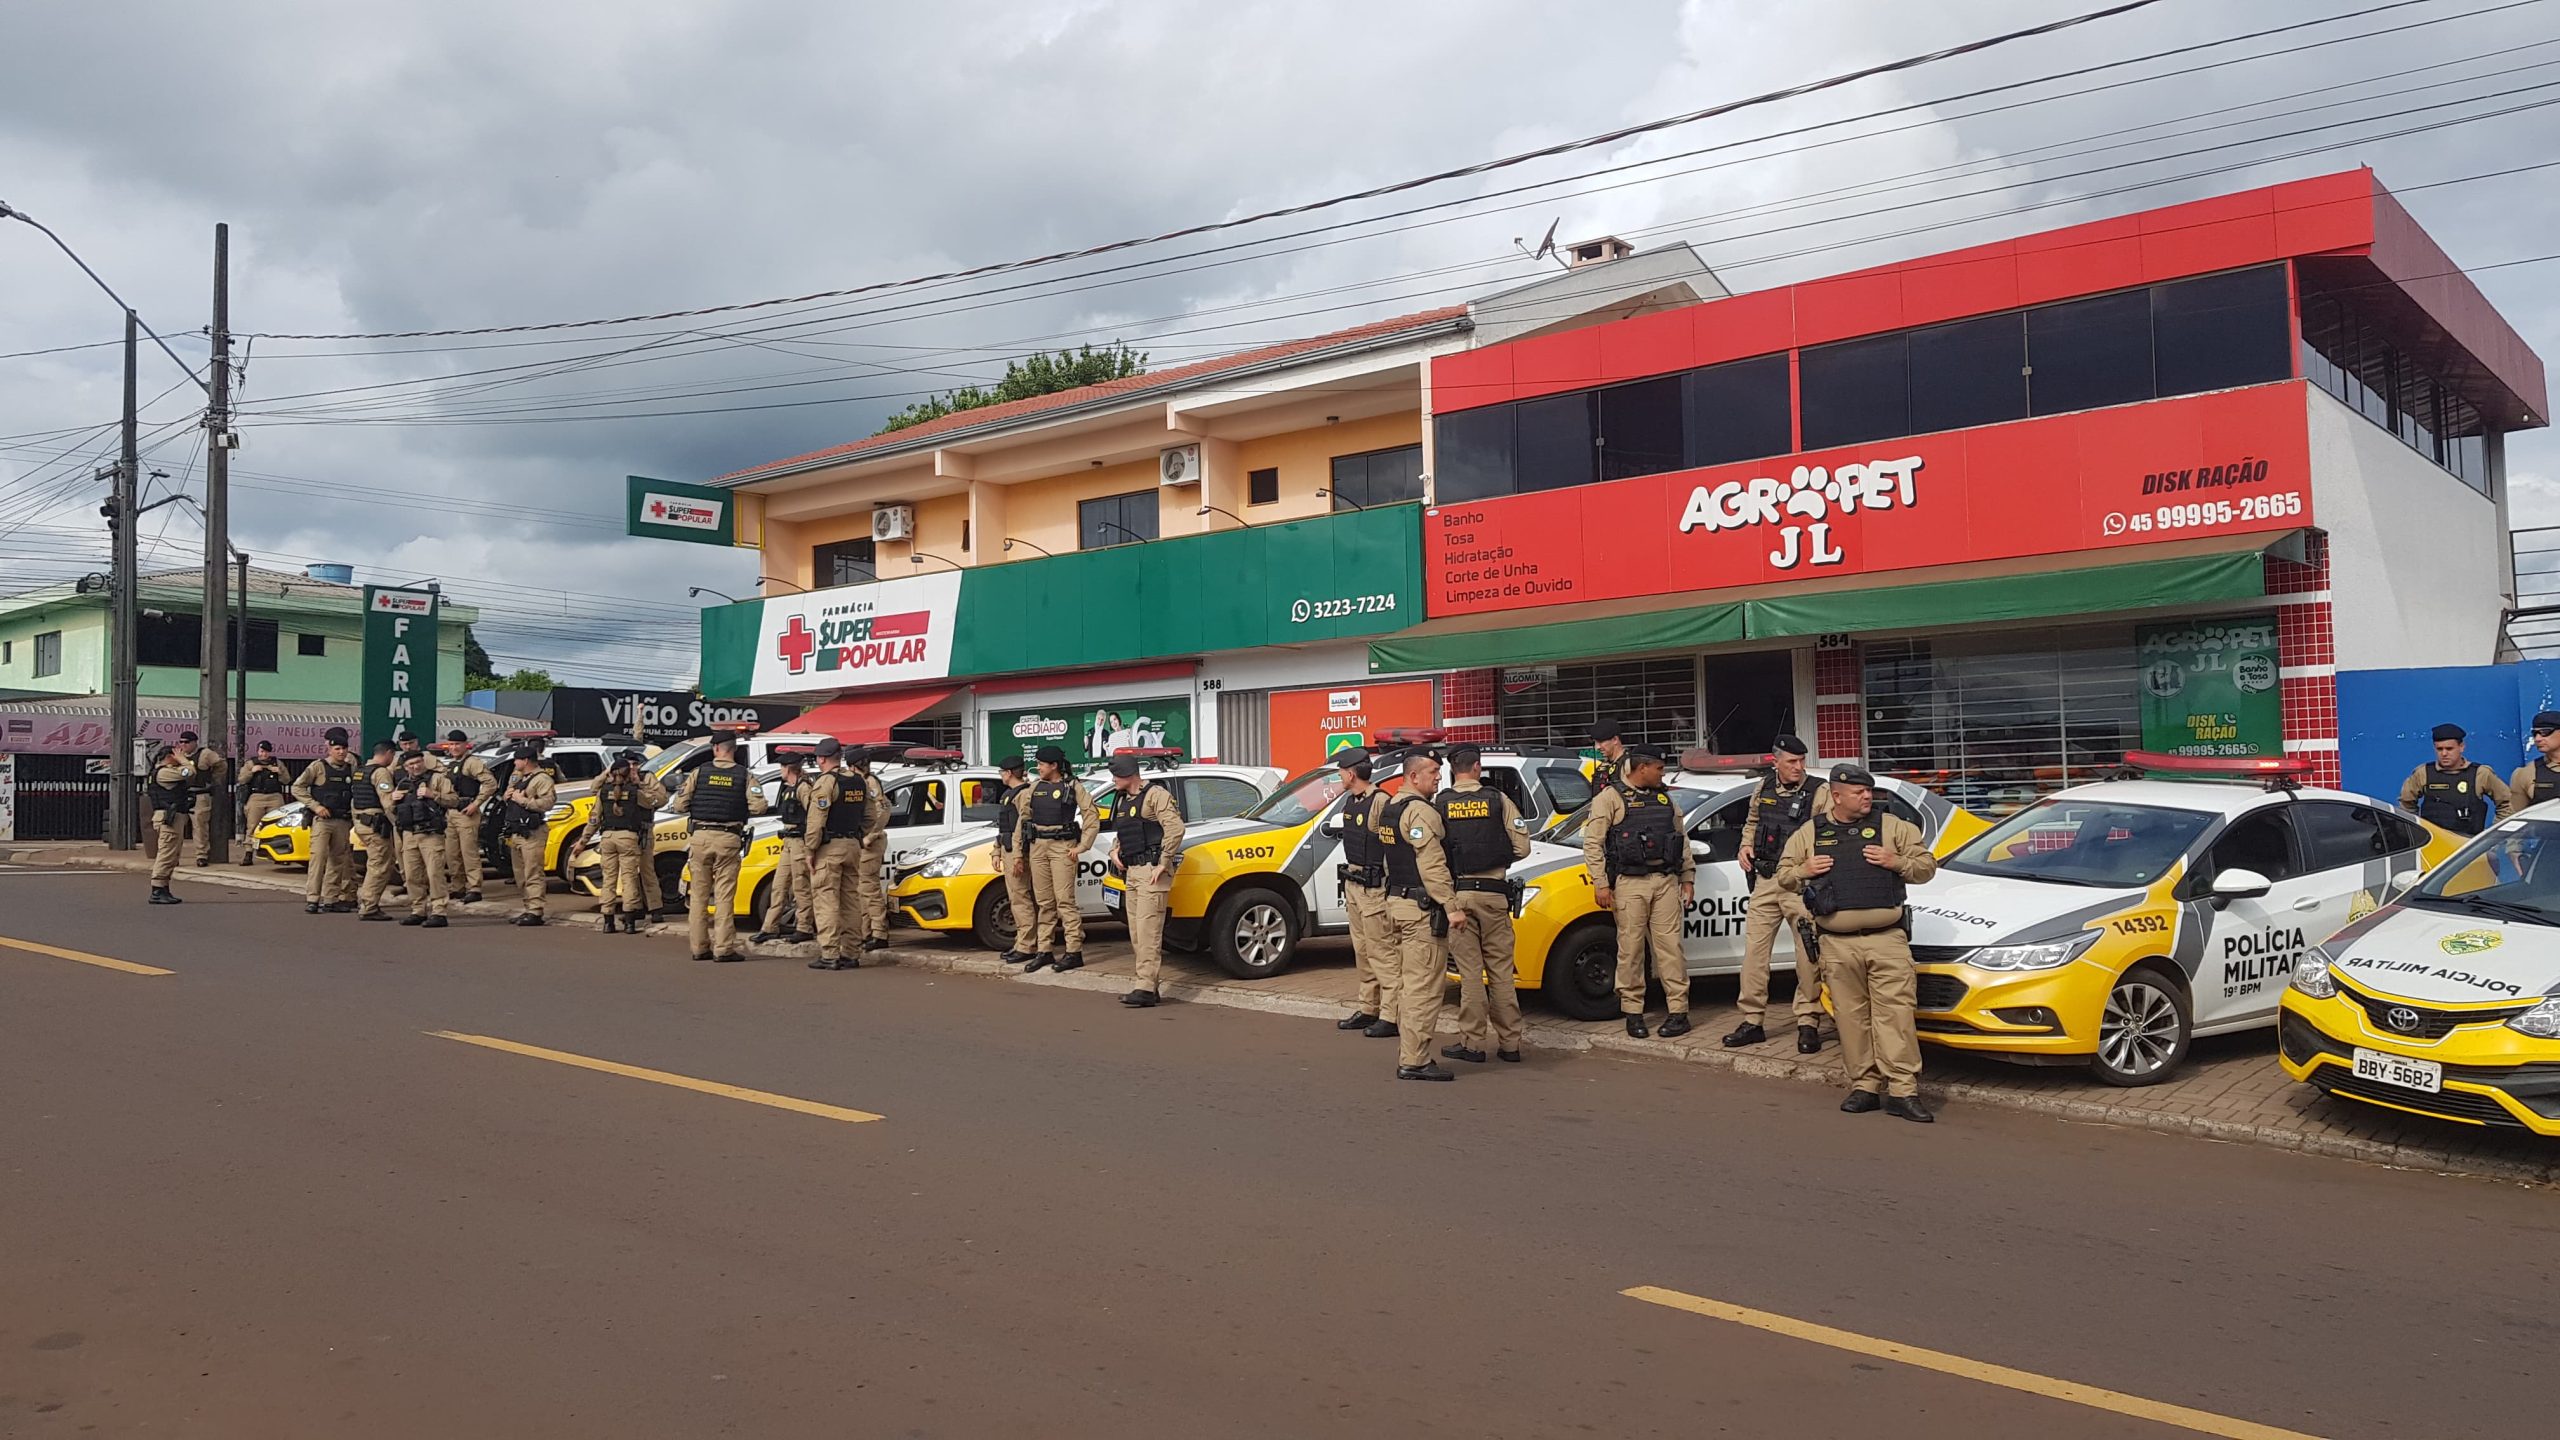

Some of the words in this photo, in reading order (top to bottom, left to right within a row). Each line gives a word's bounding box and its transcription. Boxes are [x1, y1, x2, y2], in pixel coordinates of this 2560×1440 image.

[2142, 469, 2193, 495] DISK
[2196, 456, 2269, 489] RAÇÃO
[677, 514, 713, 524] POPULAR
[1443, 512, 1484, 527] Banho
[2130, 514, 2152, 531] 45
[2157, 492, 2301, 530] 99995-2665
[1444, 533, 1474, 546] Tosa
[1444, 546, 1513, 565] Hidratação
[1445, 569, 1479, 584] Corte
[1483, 567, 1499, 580] de
[1503, 563, 1538, 577] Unha
[1446, 588, 1499, 603] Limpeza
[1503, 584, 1520, 596] de
[1525, 577, 1573, 594] Ouvido
[822, 602, 874, 616] FARMÁCIA
[1314, 593, 1396, 619] 3223-7224
[1819, 634, 1849, 648] 584
[838, 638, 927, 670] POPULAR
[2239, 664, 2268, 673] Banho
[388, 617, 412, 745] FARMÁ
[1203, 680, 1222, 691] 588
[1504, 673, 1540, 683] ALGOMIX
[601, 694, 678, 726] Vilão
[688, 701, 758, 727] Store
[1014, 718, 1067, 736] CREDIÁRIO
[1320, 717, 1343, 731] AQUI
[1346, 715, 1367, 728] TEM
[2187, 714, 2217, 727] DISK
[278, 727, 315, 737] PNEUS
[2195, 725, 2237, 741] RAÇÃO
[2178, 744, 2248, 756] 99995-2665
[1448, 800, 1489, 810] POLÍCIA
[1448, 809, 1489, 819] MILITAR
[1226, 846, 1275, 860] 14807
[1684, 917, 1746, 939] MILIT
[2113, 915, 2169, 935] 14392
[2224, 925, 2306, 959] POLÍCIA
[2240, 982, 2262, 996] BPM
